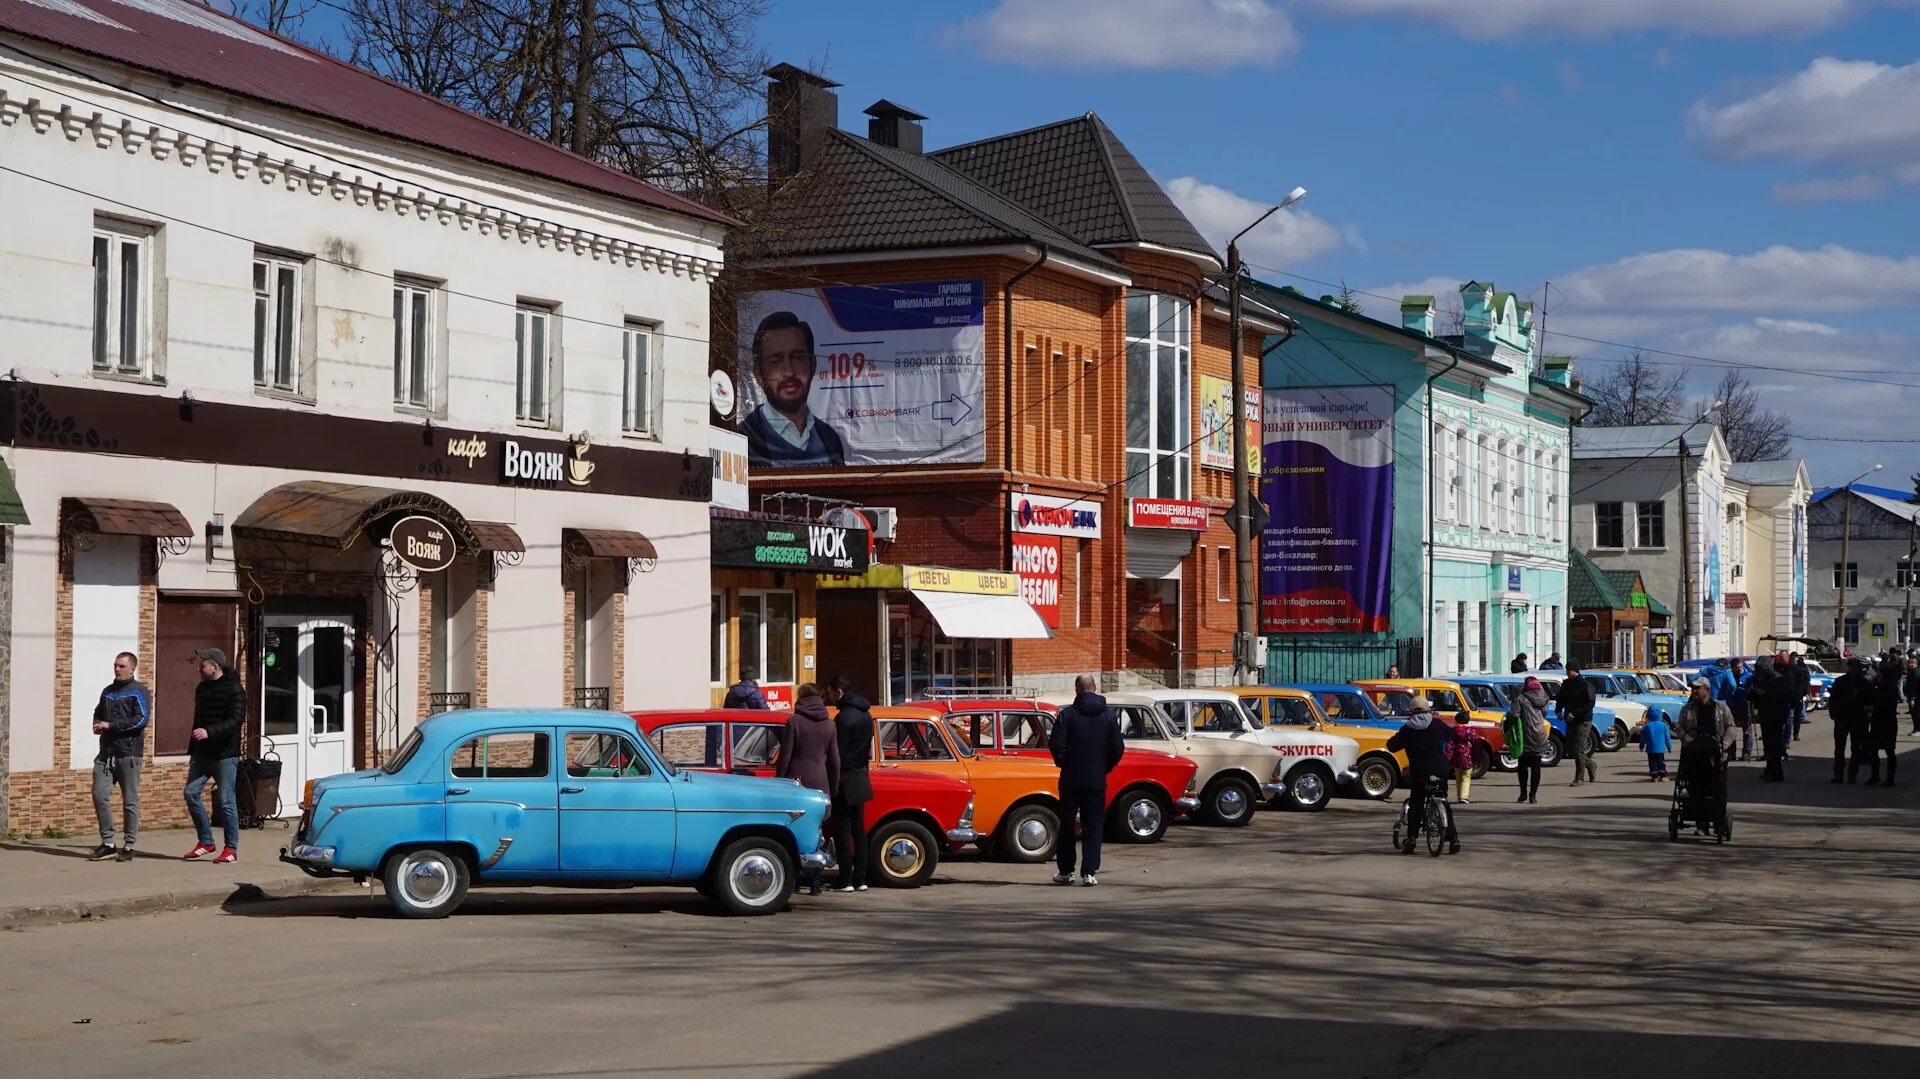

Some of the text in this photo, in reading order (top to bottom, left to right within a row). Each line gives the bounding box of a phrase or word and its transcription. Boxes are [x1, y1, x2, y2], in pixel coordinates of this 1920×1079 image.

[938, 283, 972, 294] ГАРАНТИЯ
[894, 296, 972, 309] МИНИМАЛЬНОЙ СТАВКИ
[895, 355, 973, 368] 8 800 100 000 6
[855, 407, 921, 417] СОВКОМБАНК
[1281, 401, 1326, 416] успешной
[1329, 400, 1368, 413] карьере!
[447, 434, 563, 481] кафе Вояж
[1269, 464, 1325, 475] образования
[1136, 503, 1185, 517] ПОМЕЩЕНИЯ
[427, 530, 444, 543] кафе
[808, 525, 847, 559] WOK
[407, 535, 441, 561] Вояж
[1012, 545, 1058, 575] МНОГО
[1334, 565, 1355, 573] дела.
[919, 570, 1008, 590] ЦВЕТЫ ЦВЕТЫ
[1284, 598, 1346, 607] info@rosnou.ru
[1300, 616, 1361, 626] gk_wm@mail.ru
